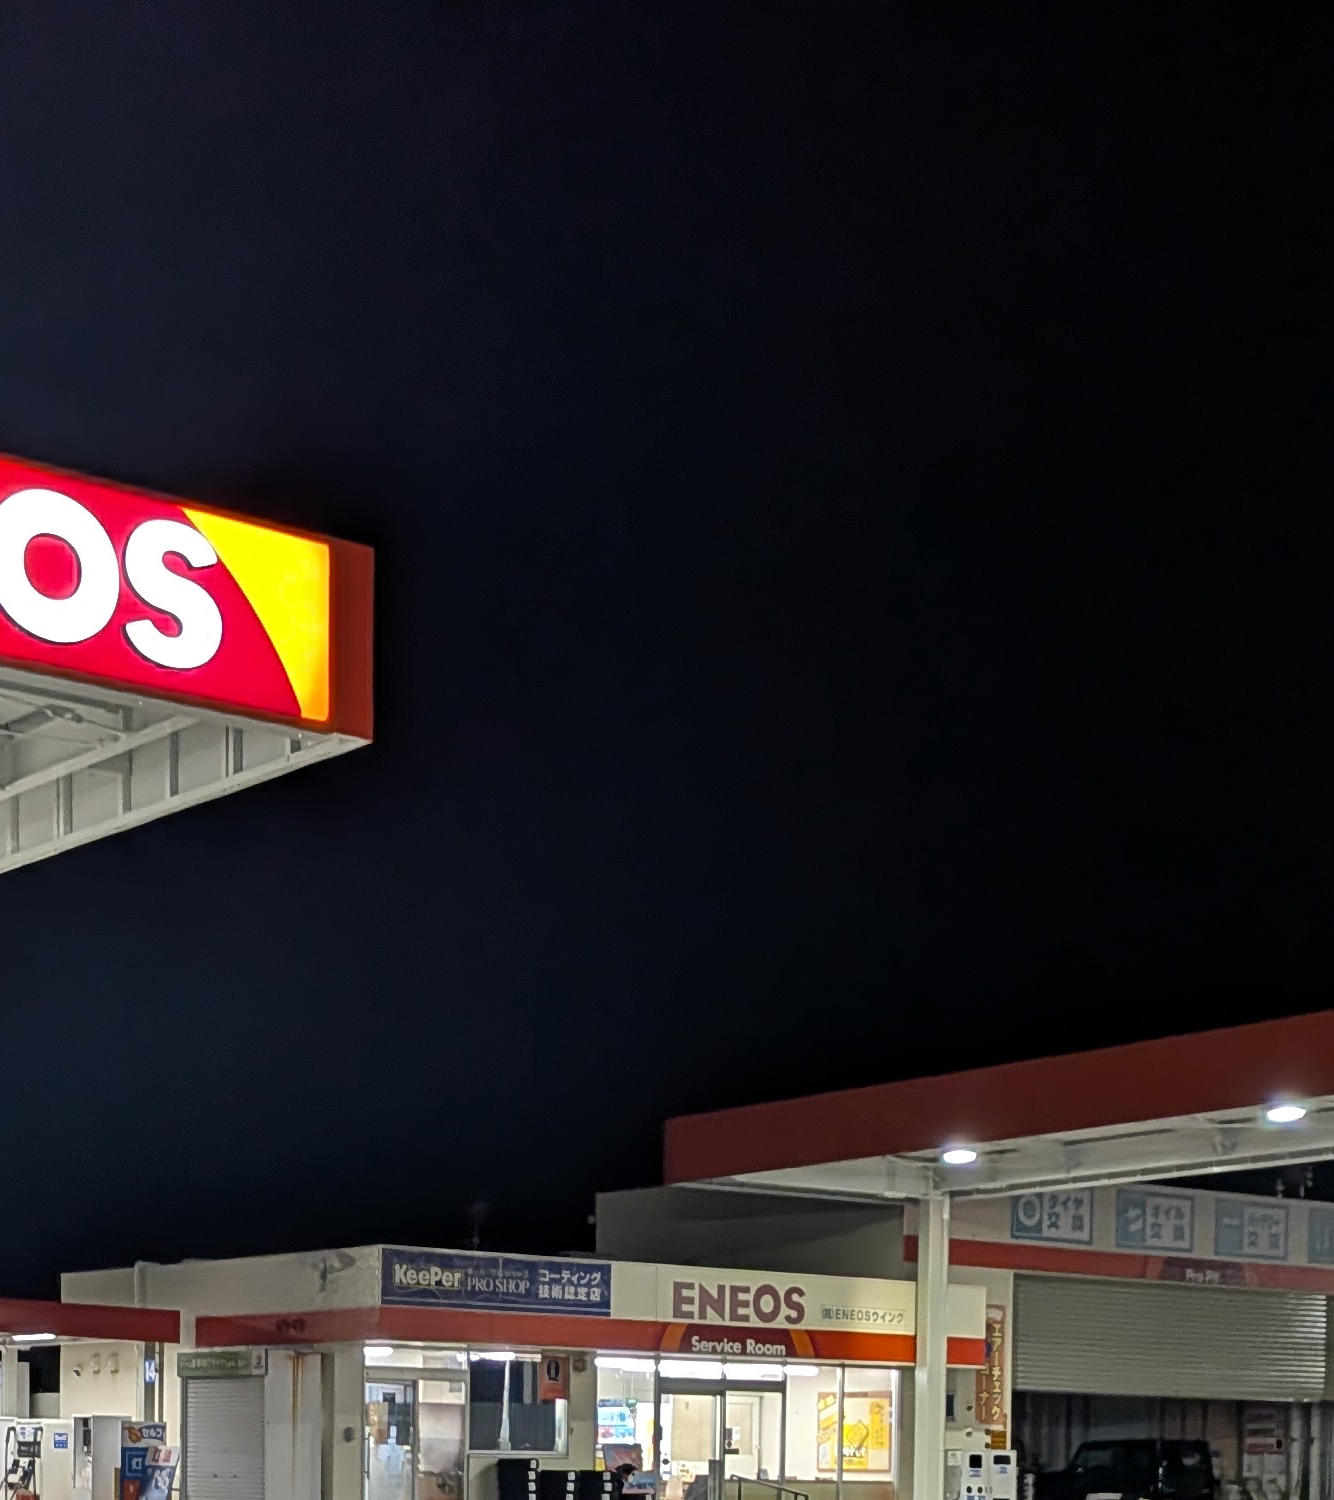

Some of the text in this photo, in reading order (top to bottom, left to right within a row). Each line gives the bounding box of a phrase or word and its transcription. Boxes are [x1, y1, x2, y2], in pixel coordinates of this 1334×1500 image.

[394, 1264, 462, 1288] KeePer
[467, 1276, 530, 1294] PRO SHOP
[539, 1269, 601, 1285] コーティング
[673, 1280, 806, 1324] ENEOS
[691, 1335, 786, 1356] Service Room
[145, 1360, 156, 1381] 14
[990, 1323, 1002, 1421] エアーチェック
